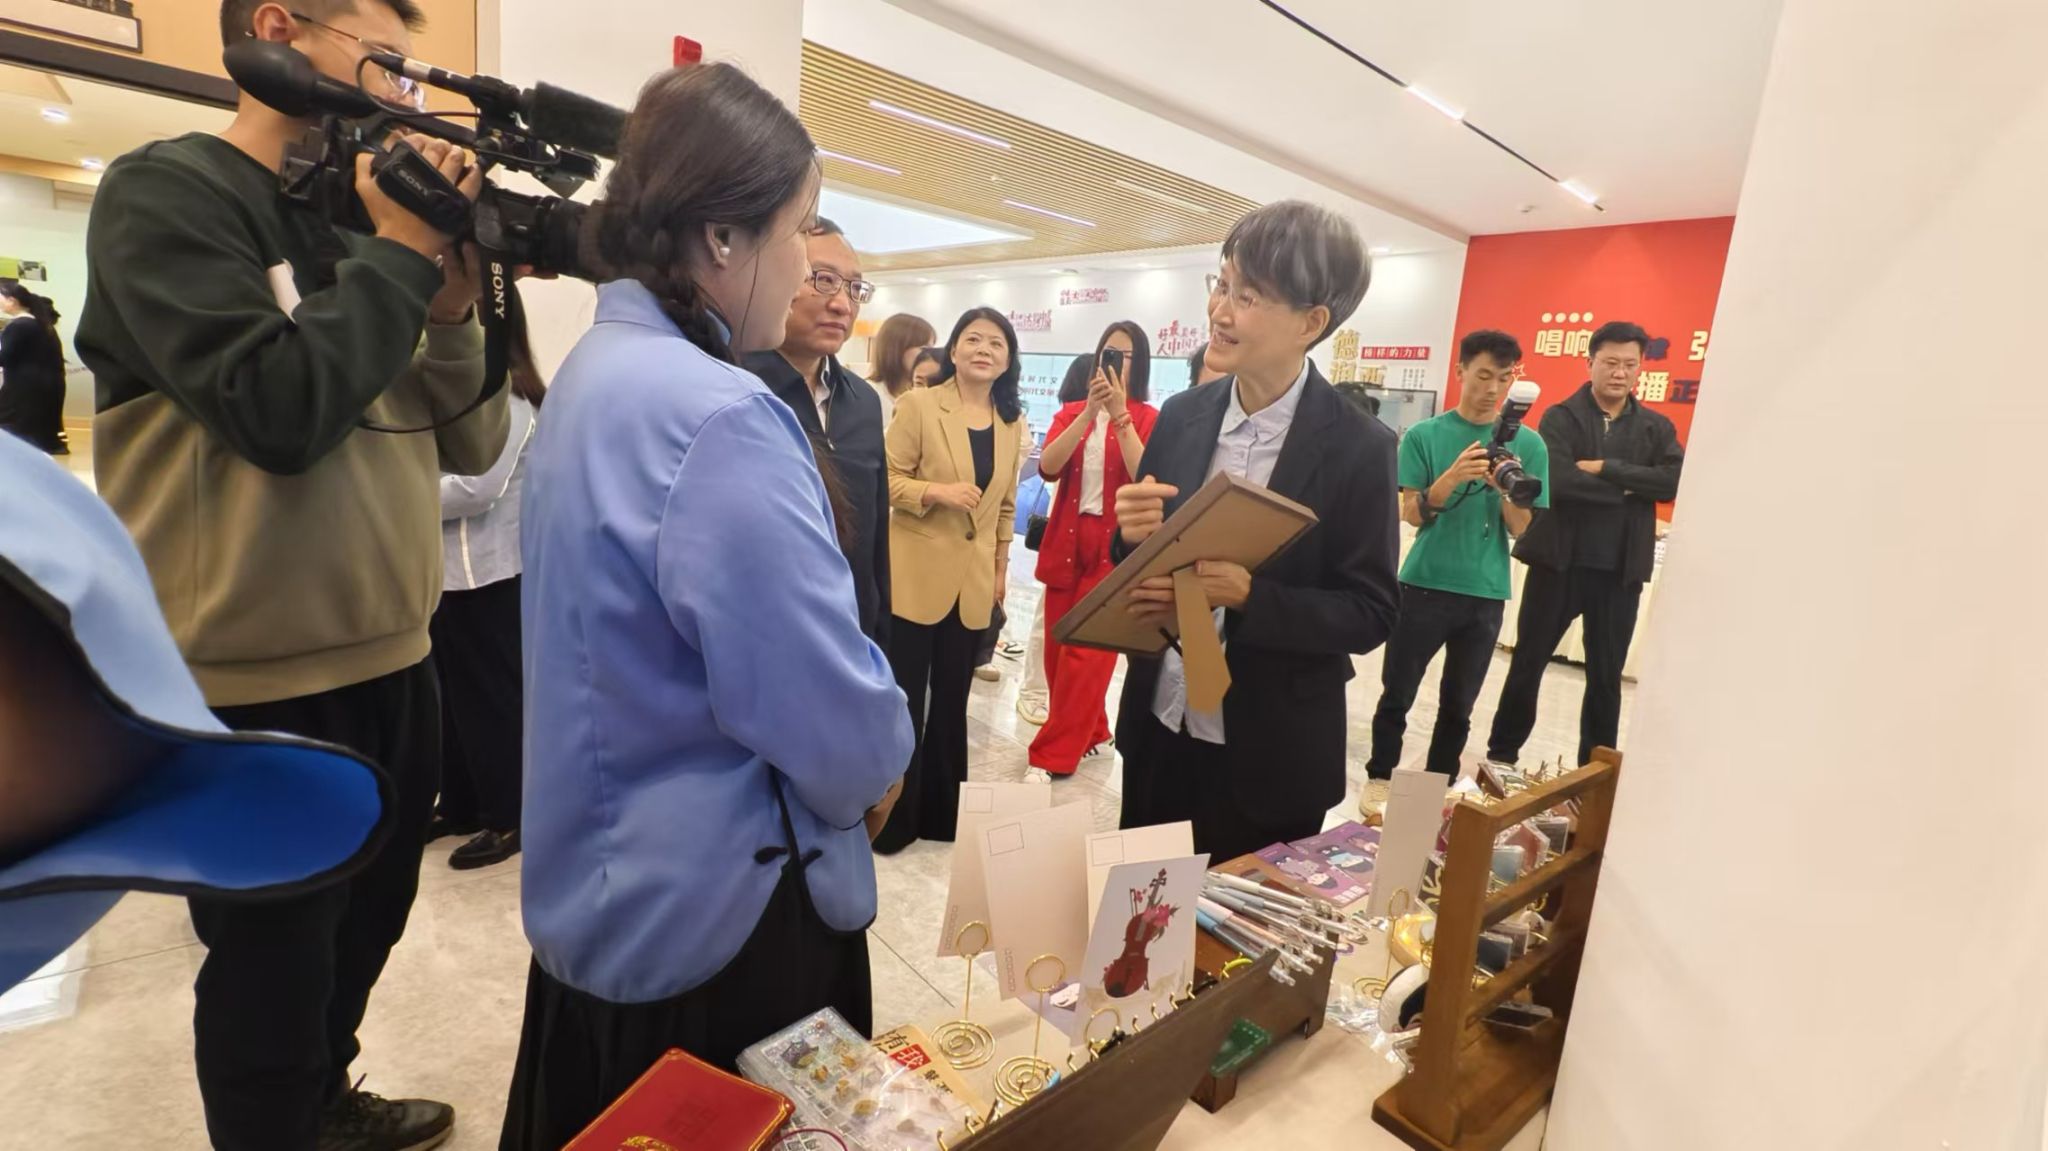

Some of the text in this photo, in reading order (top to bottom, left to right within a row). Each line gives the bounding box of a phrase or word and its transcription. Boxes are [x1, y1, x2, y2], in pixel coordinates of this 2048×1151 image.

[398, 169, 428, 196] SONY
[491, 262, 505, 320] SONY
[1634, 371, 1700, 404] 播正
